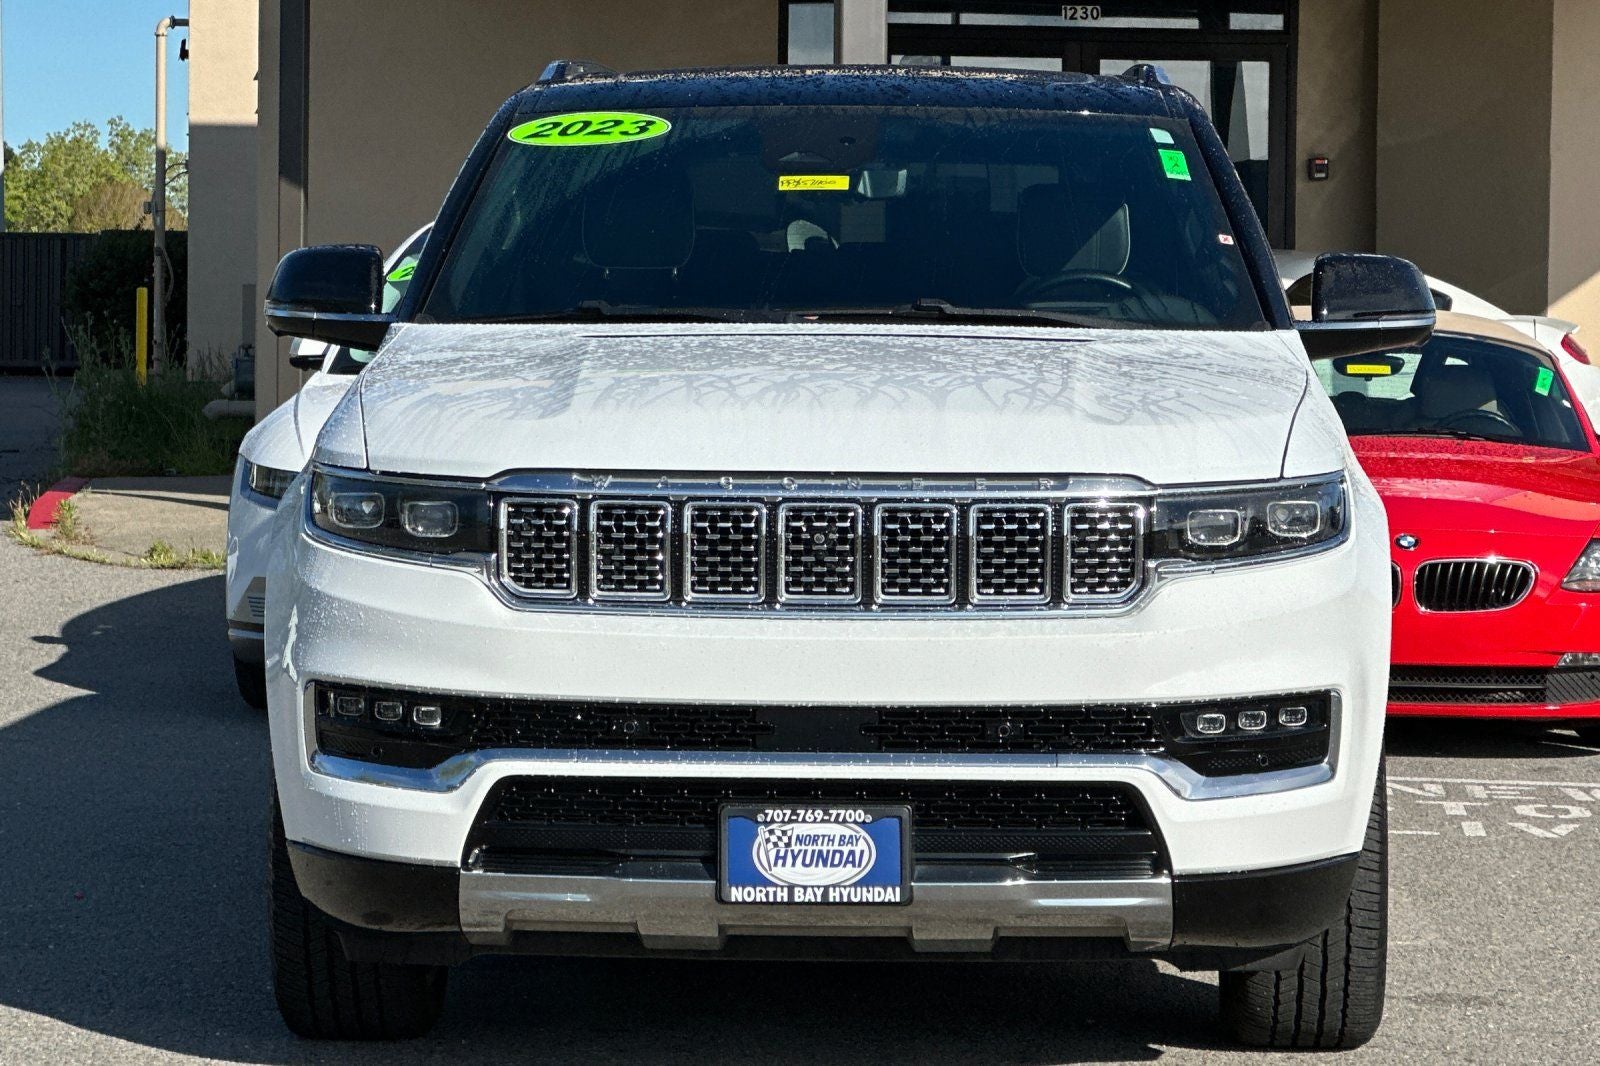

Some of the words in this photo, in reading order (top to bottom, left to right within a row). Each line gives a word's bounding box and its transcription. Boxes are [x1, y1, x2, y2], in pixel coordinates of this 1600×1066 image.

[1062, 6, 1100, 20] 1230
[523, 119, 657, 139] 2023
[764, 809, 866, 823] 707-769-7700
[794, 833, 834, 846] NORTH
[838, 833, 862, 846] BAY
[773, 849, 865, 868] HYUNDAI
[731, 886, 788, 902] NORTH
[794, 886, 824, 902] BAY
[829, 886, 900, 902] HYUNDAI
